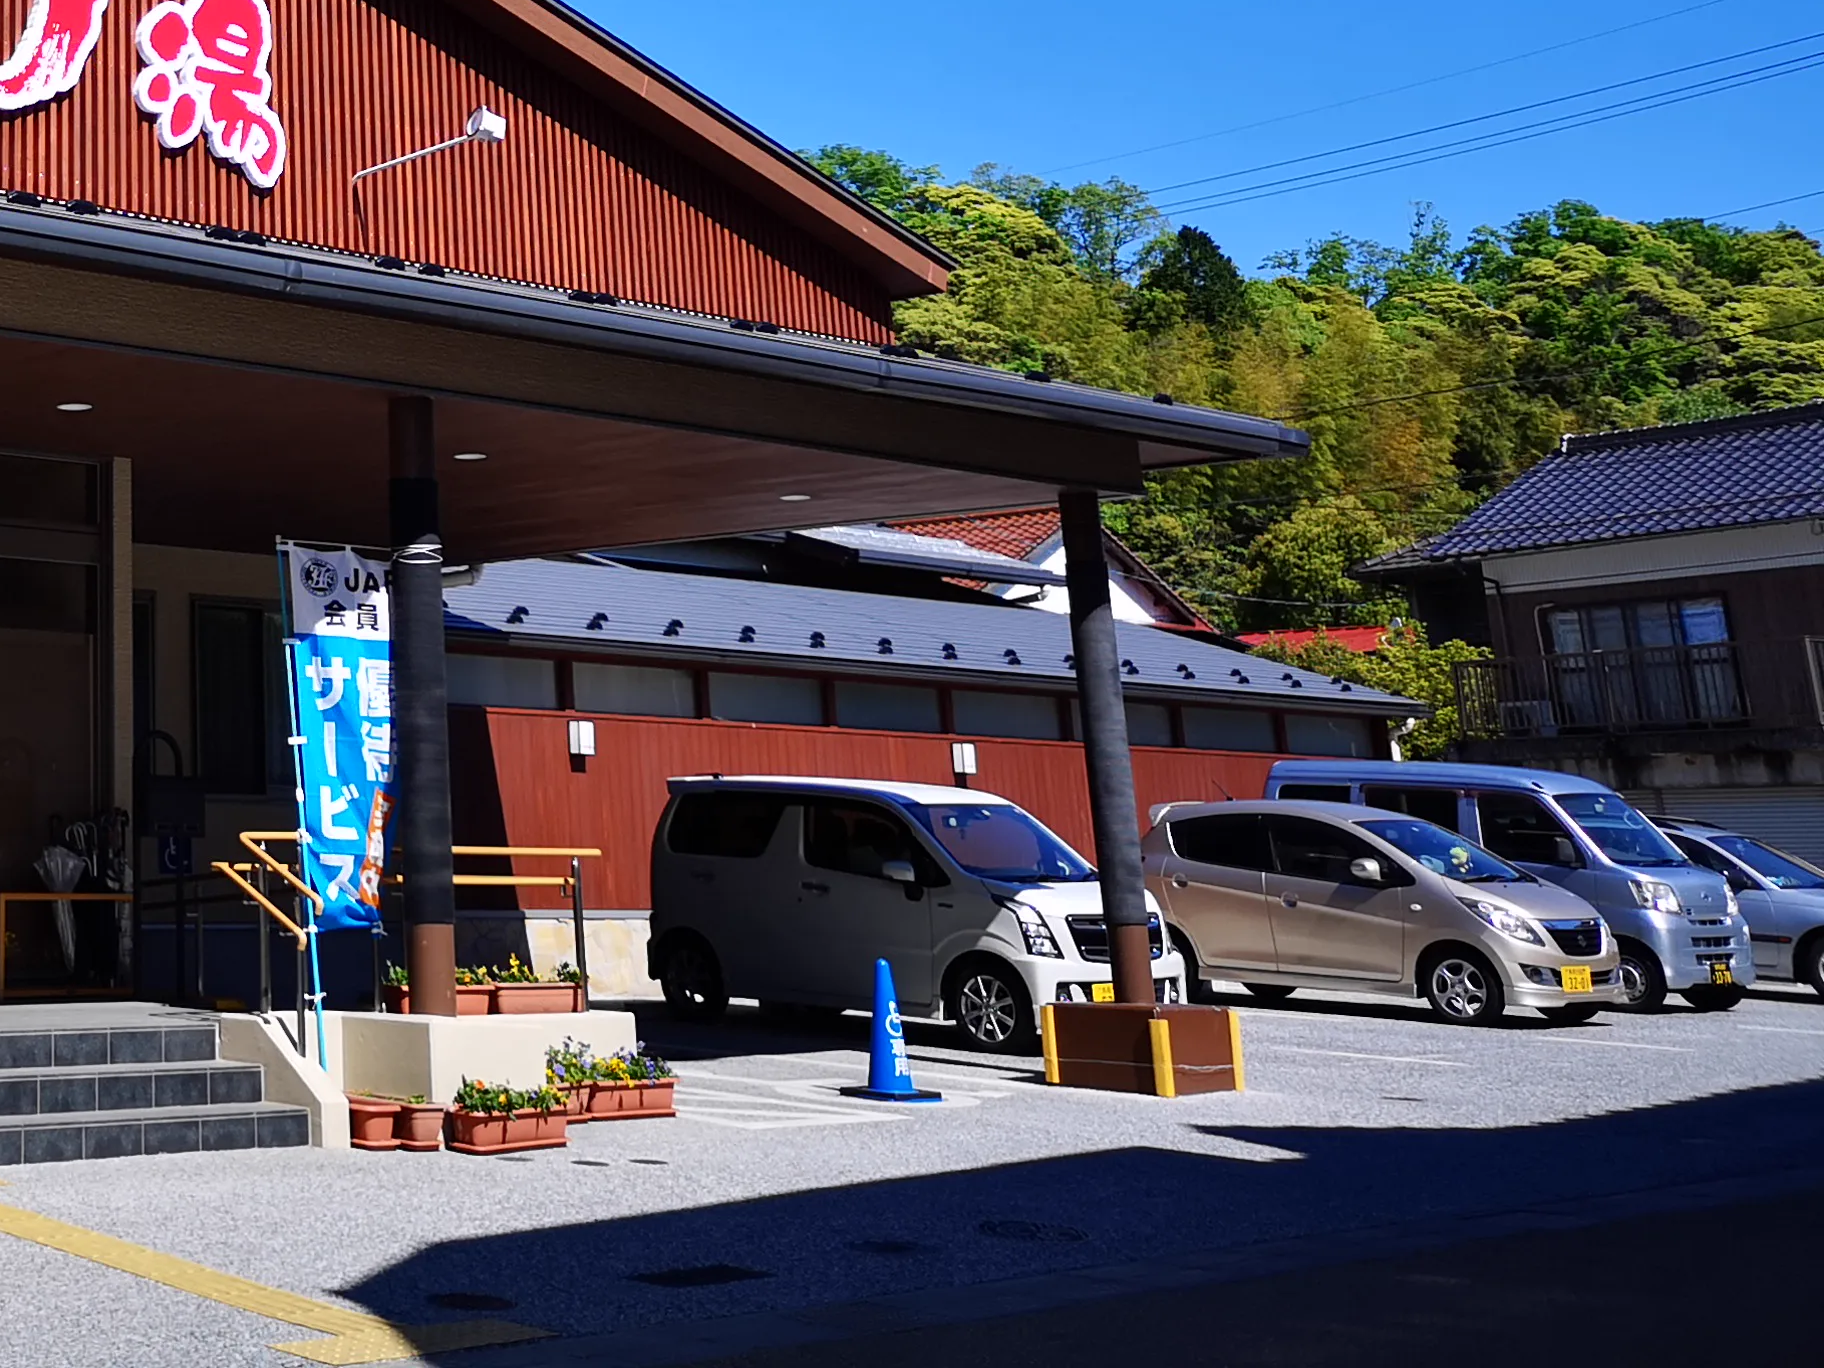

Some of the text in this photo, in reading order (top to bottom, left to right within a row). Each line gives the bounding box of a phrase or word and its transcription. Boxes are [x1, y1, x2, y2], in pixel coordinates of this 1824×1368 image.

[323, 599, 379, 631] 会員
[305, 655, 361, 901] サービス
[356, 657, 397, 783] 優待
